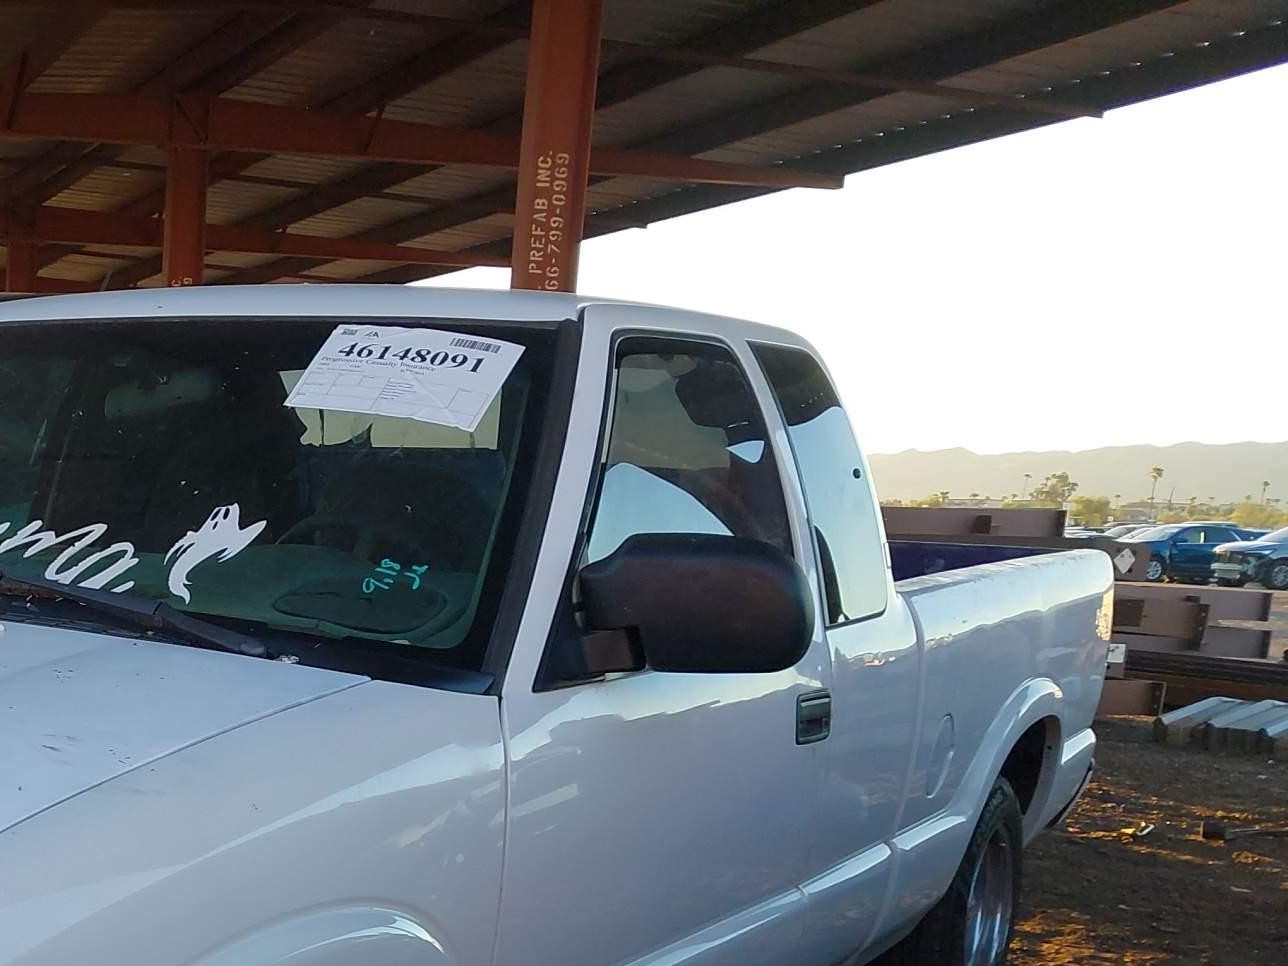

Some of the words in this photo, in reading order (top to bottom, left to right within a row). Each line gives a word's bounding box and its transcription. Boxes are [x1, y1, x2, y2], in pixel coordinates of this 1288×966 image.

[536, 150, 553, 187] INC.
[529, 198, 548, 273] PREFAB
[338, 342, 486, 373] 46148091
